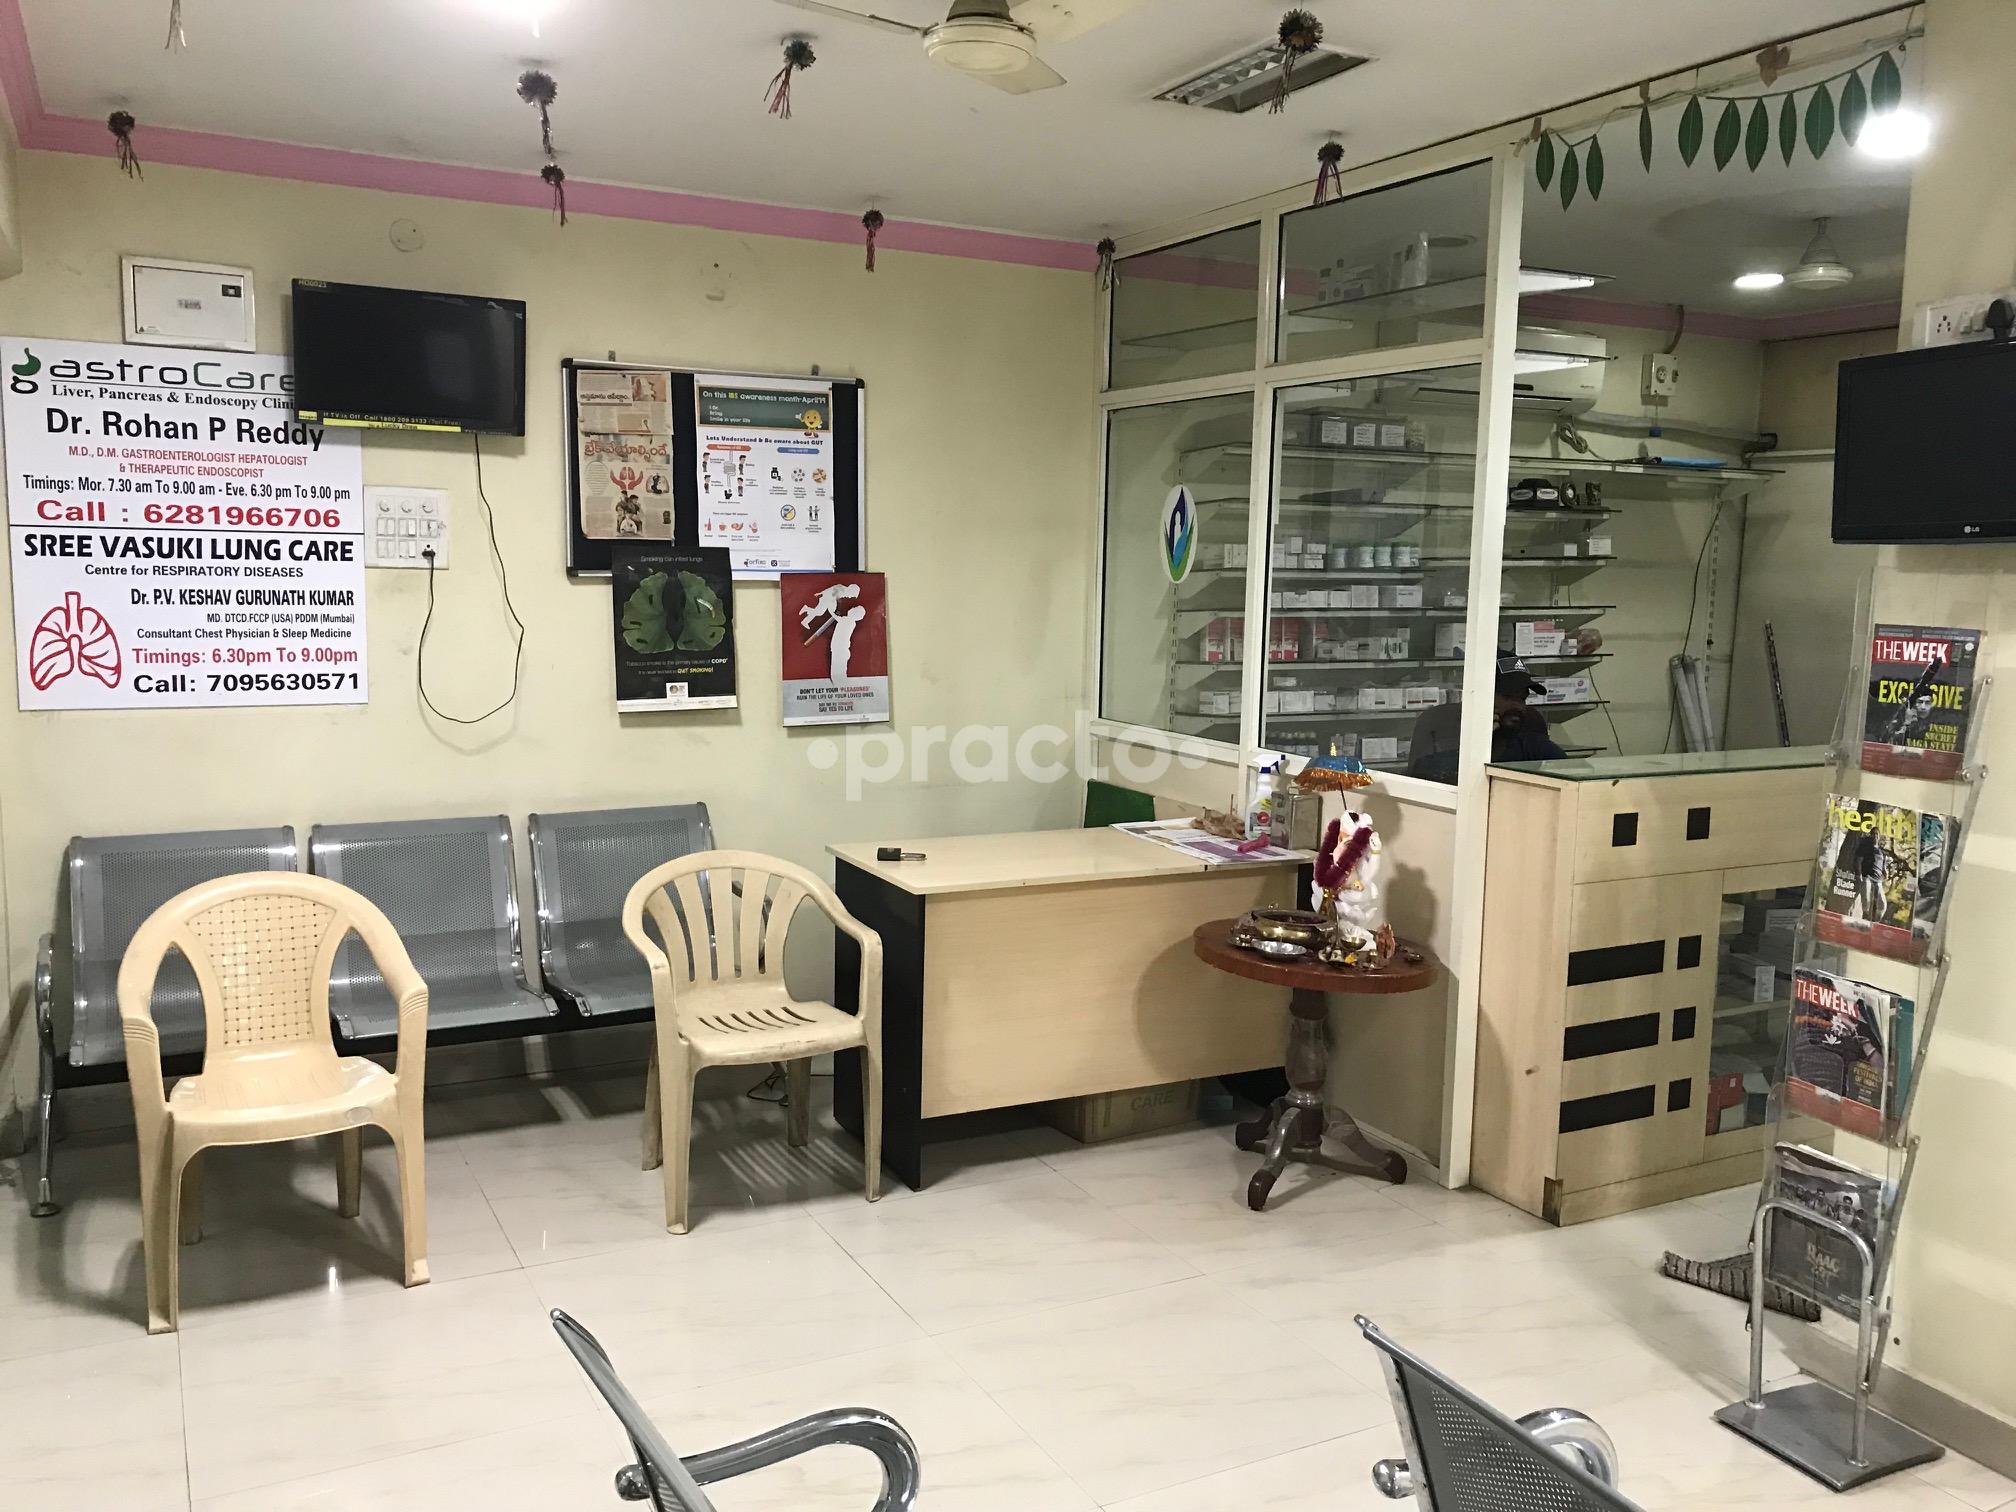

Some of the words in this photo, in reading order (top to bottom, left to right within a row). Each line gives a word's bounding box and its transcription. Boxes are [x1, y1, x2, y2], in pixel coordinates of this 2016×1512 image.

[52, 384, 95, 400] Liver,
[99, 387, 163, 402] Pancreas
[166, 391, 180, 404] &
[185, 392, 258, 410] Endoscopy
[262, 397, 295, 410] Clini
[702, 390, 713, 398] On
[714, 391, 727, 399] this
[740, 393, 777, 402] awareness
[46, 408, 91, 434] Dr.
[102, 410, 198, 440] Rohan
[209, 416, 226, 441] P
[237, 418, 324, 451] Reddy
[68, 446, 95, 458] M.D.,
[97, 447, 119, 458] D.M.
[121, 448, 235, 463] GASTROENTEROLOGIST
[238, 453, 308, 466] HEPATOLOGIST
[119, 463, 126, 473] &
[129, 463, 195, 476] THERAPEUTIC
[197, 466, 264, 478] ENDOSCOPIST
[22, 474, 74, 493] Timings:
[78, 477, 105, 491] Mor.
[108, 478, 132, 493] 7.30
[135, 482, 152, 493] am
[155, 479, 170, 494] To
[173, 480, 196, 495] 9.00
[198, 484, 215, 495] am
[225, 482, 248, 496] Eve.
[250, 484, 272, 497] 6.30
[275, 487, 292, 500] pm
[294, 485, 308, 498] To
[310, 486, 331, 499] 9.00
[334, 489, 350, 502] pm
[37, 499, 106, 522] Call
[143, 504, 341, 528] 6281966706
[24, 533, 93, 557] SREE
[99, 535, 202, 559] VASUKI
[211, 538, 281, 561] LUNG
[288, 539, 354, 562] CARE
[85, 564, 128, 575] Centre
[131, 565, 149, 576] for
[153, 565, 240, 577] RESPIRATORY
[244, 566, 304, 578] DISEASES
[131, 588, 149, 605] Dr.
[153, 588, 175, 605] P.V.
[179, 588, 232, 606] KESHAV
[235, 589, 306, 606] GURUNATH
[309, 590, 354, 606] KUMAR
[271, 613, 294, 624] (USA)
[295, 613, 319, 623] PDDM
[320, 613, 355, 624] (Mumbai)
[137, 628, 192, 639] Consultant
[194, 628, 223, 639] Chest
[225, 628, 270, 640] Physician
[272, 628, 279, 638] &
[281, 628, 308, 640] Sleep
[310, 628, 352, 638] Medicine
[131, 648, 206, 667] Timings:
[212, 647, 271, 667] 6.30pm
[276, 647, 297, 663] To
[301, 647, 358, 666] 9.00pm
[133, 674, 196, 693] Call:
[206, 672, 358, 692] 7095630571
[1828, 799, 1914, 841] health
[1833, 885, 1857, 898] Runner
[1836, 877, 1855, 890] Blade
[1130, 1089, 1176, 1112] CARE
